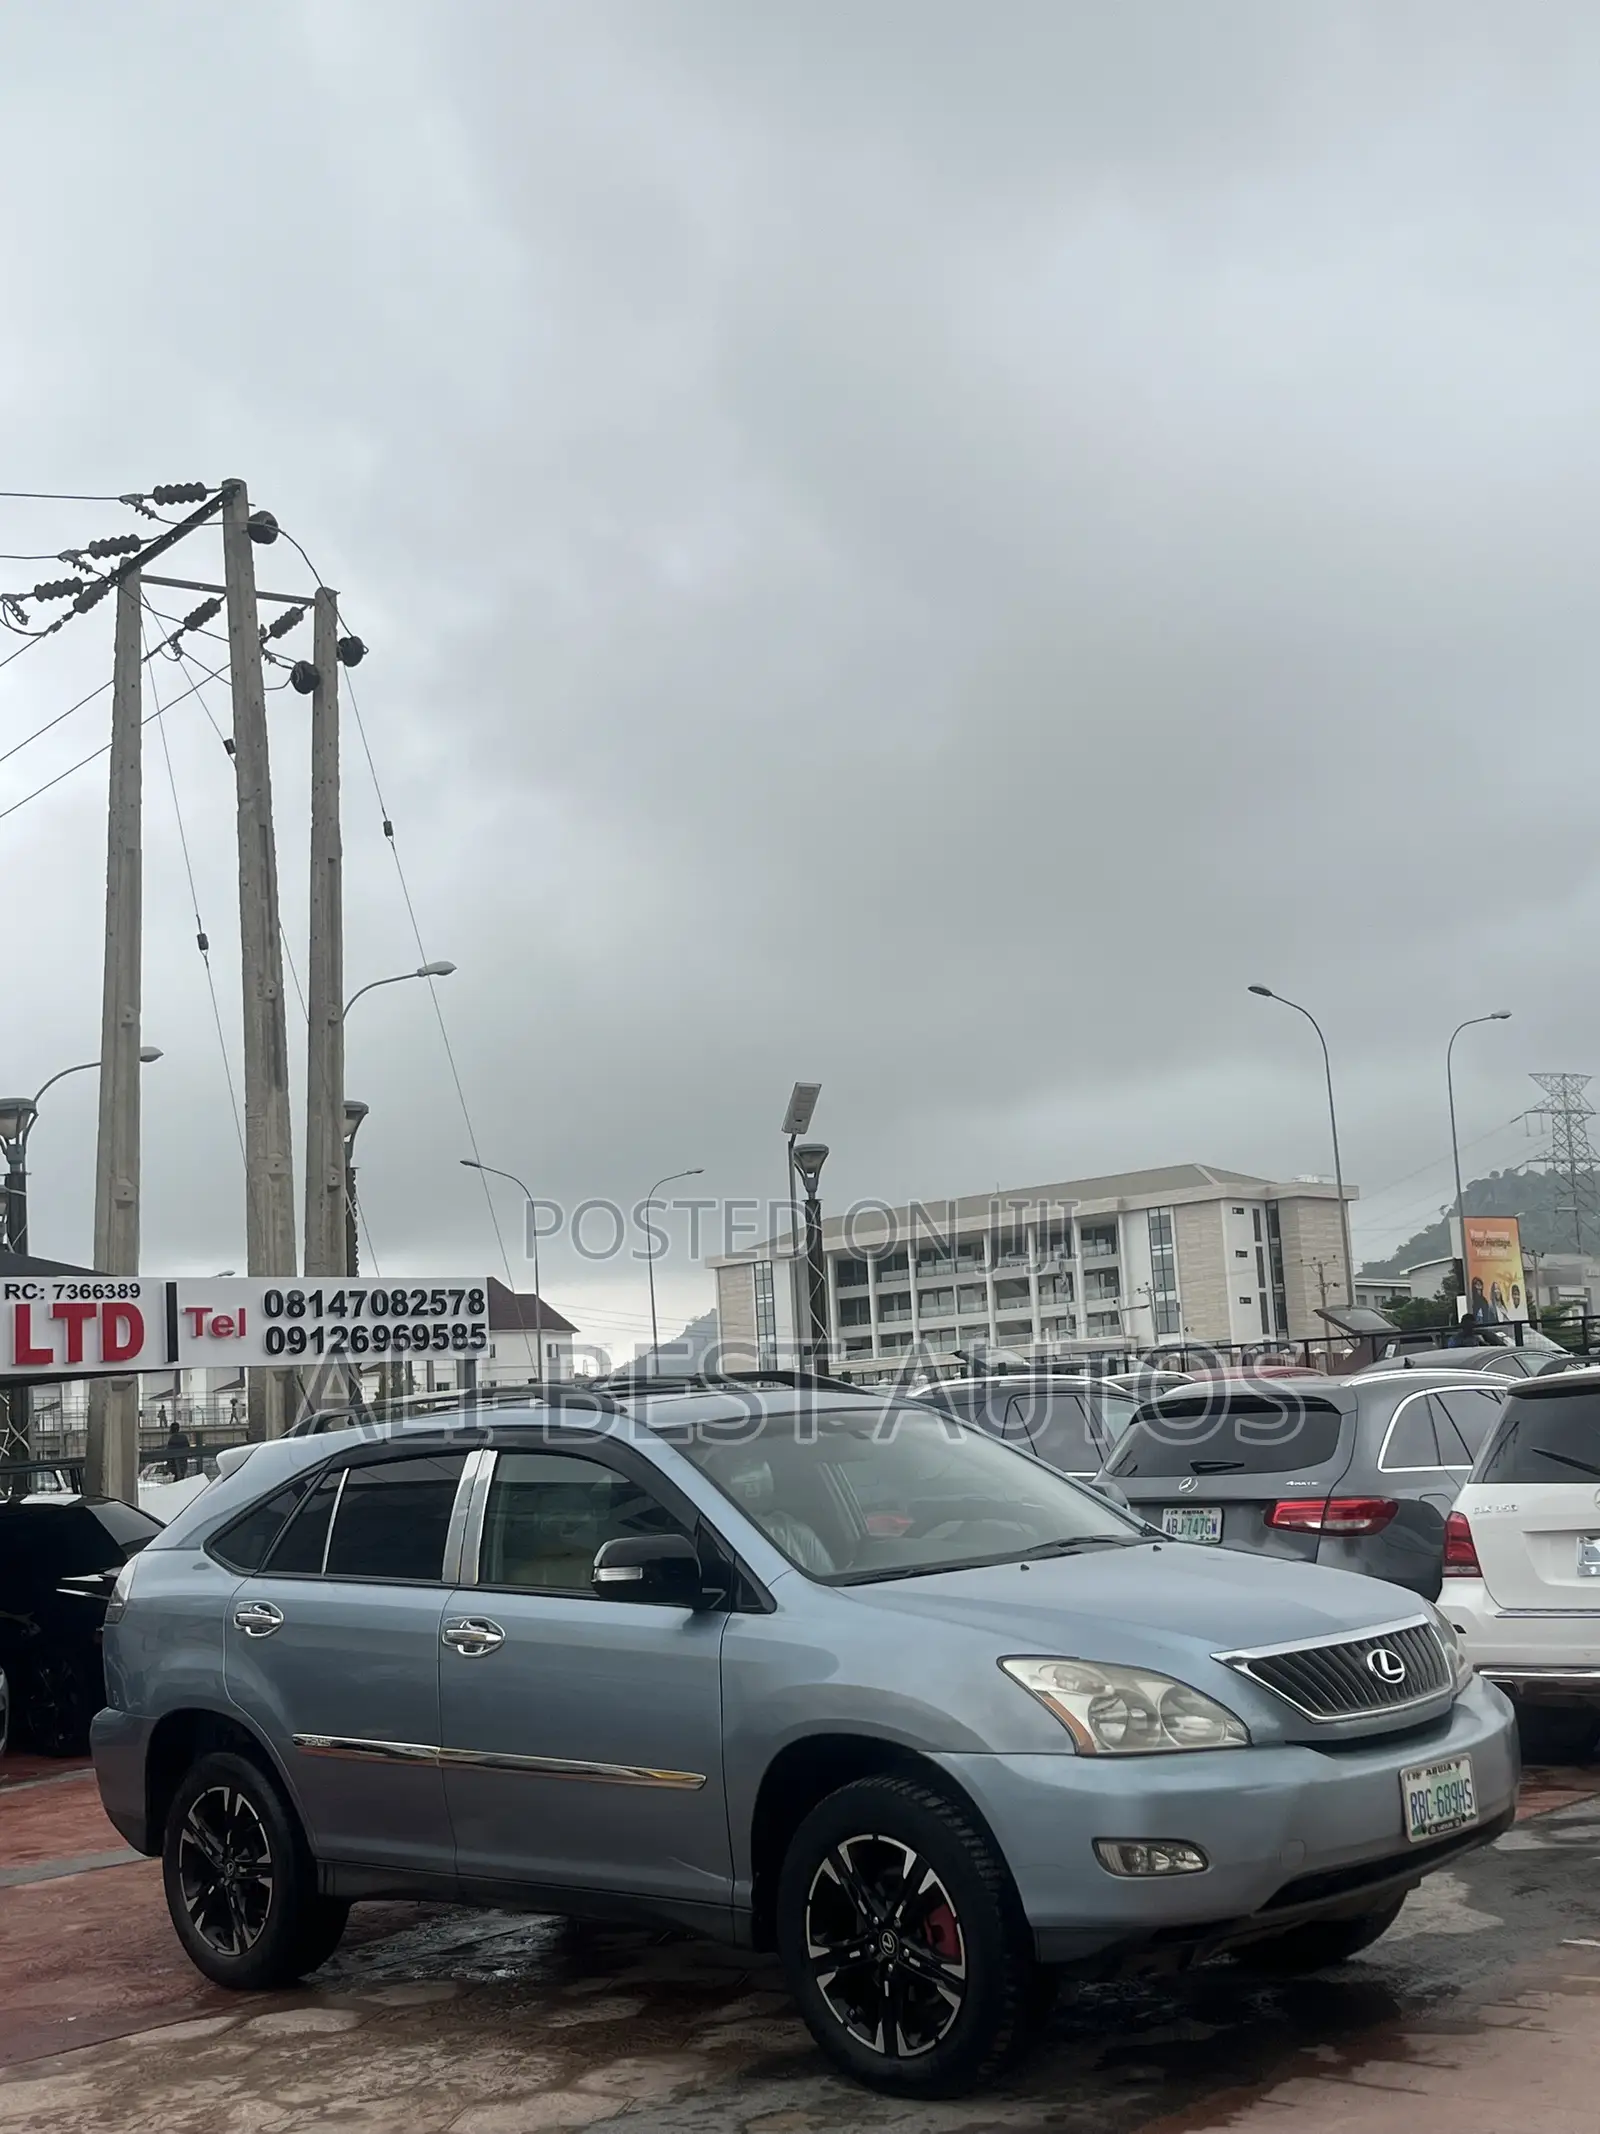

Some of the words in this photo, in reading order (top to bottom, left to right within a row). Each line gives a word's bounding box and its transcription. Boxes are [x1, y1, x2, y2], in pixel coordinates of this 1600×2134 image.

[4, 1283, 45, 1300] RC:
[52, 1283, 141, 1300] 7366389
[264, 1289, 485, 1318] 08147082578
[12, 1302, 145, 1365] LTD
[182, 1307, 247, 1338] Tel
[265, 1322, 487, 1355] 09126969585
